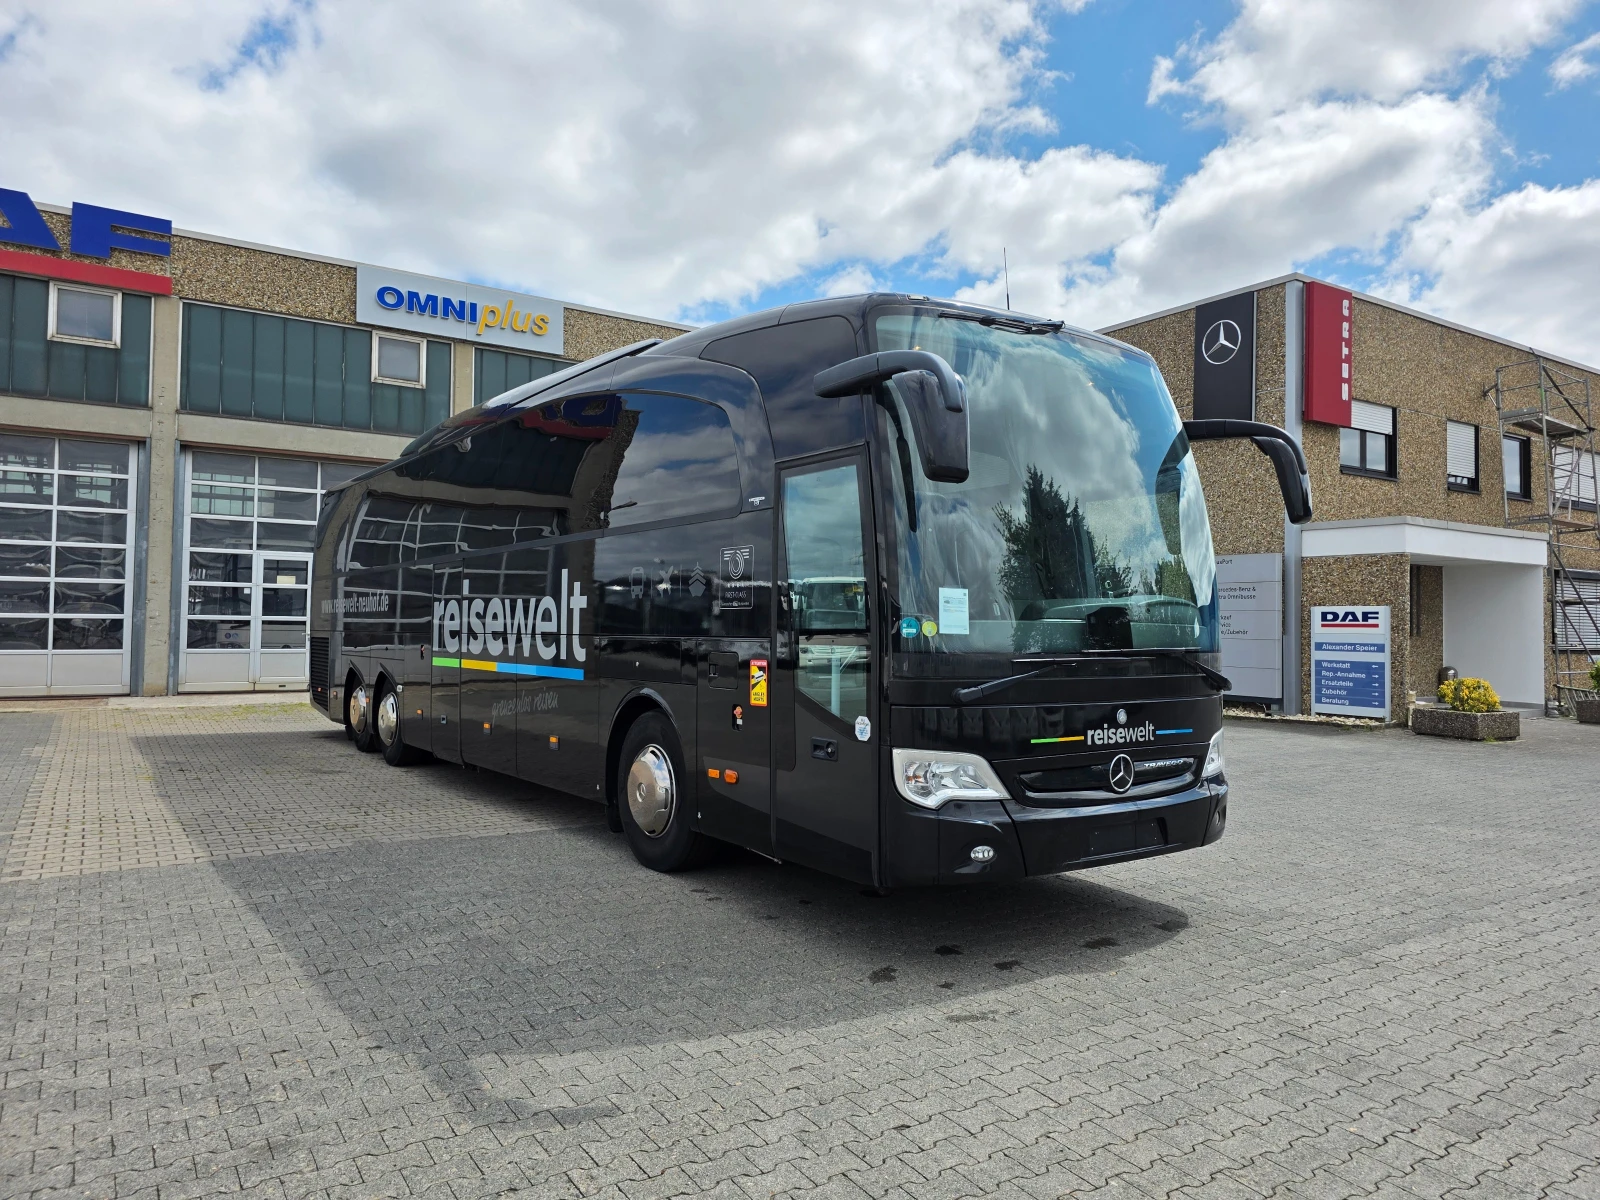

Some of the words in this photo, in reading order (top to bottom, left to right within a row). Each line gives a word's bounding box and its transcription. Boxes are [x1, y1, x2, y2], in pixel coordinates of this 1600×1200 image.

[376, 286, 550, 336] OMNIplus
[1342, 299, 1350, 401] SETRA
[321, 589, 389, 614] www.reisewelt-neuhof.de
[432, 568, 587, 662] reisewelt
[1320, 611, 1379, 622] DAF
[1322, 643, 1355, 651] Alexander
[1355, 644, 1378, 652] Speier
[1321, 661, 1351, 669] Werkstatt
[1321, 670, 1366, 679] Rep.-Annahme
[1321, 679, 1354, 687] Ersatzteile
[533, 686, 559, 711] reisen
[1321, 697, 1350, 705] Beratung
[1087, 720, 1155, 745] reisewelt
[1143, 759, 1184, 768] TRAVEGO
